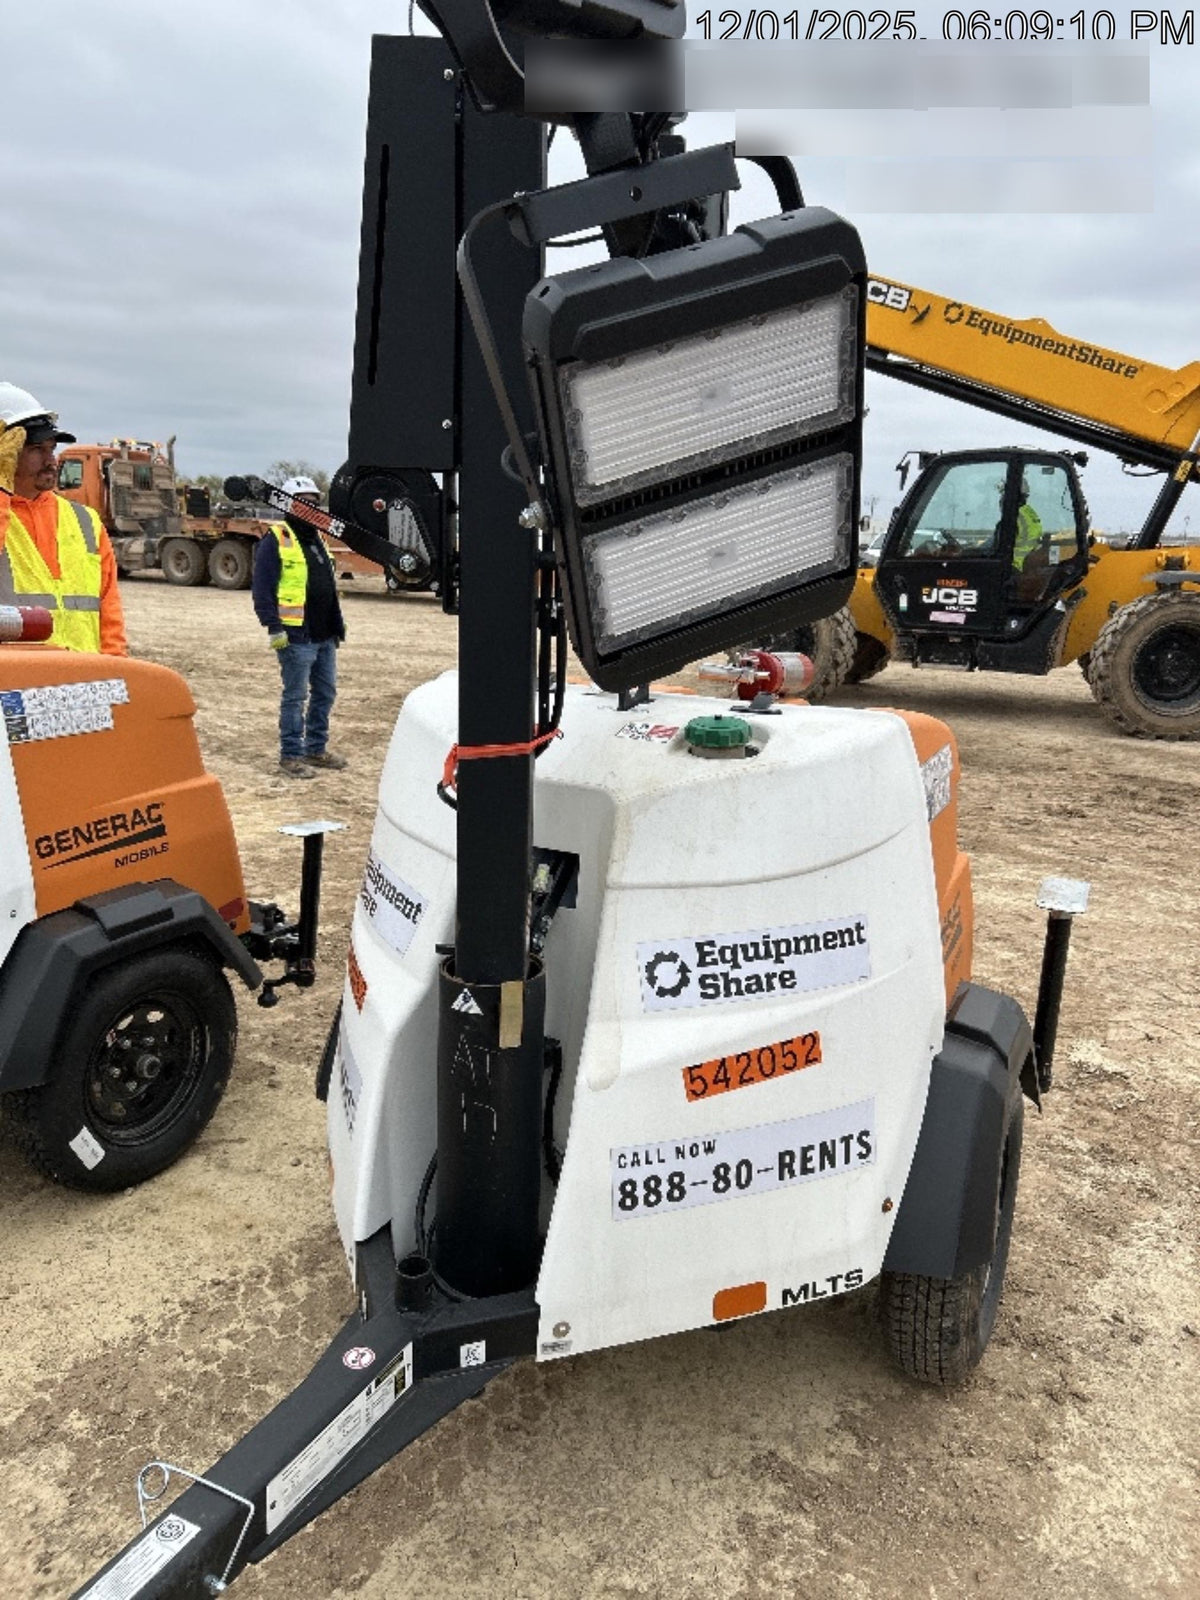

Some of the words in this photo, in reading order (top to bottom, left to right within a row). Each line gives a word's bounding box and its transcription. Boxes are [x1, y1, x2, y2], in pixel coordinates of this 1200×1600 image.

[866, 280, 910, 311] CB
[964, 310, 1139, 379] EquipmentShare
[922, 587, 977, 605] JCB
[35, 802, 164, 859] GENERAC
[114, 842, 169, 868] MOBILE
[695, 921, 866, 969] Equipment
[698, 969, 797, 999] Share
[687, 1032, 819, 1097] 542052
[617, 1147, 666, 1169] CALL
[675, 1139, 717, 1160] NOW
[618, 1129, 872, 1211] 888-80-RENTS
[782, 1268, 863, 1306] MLTS
